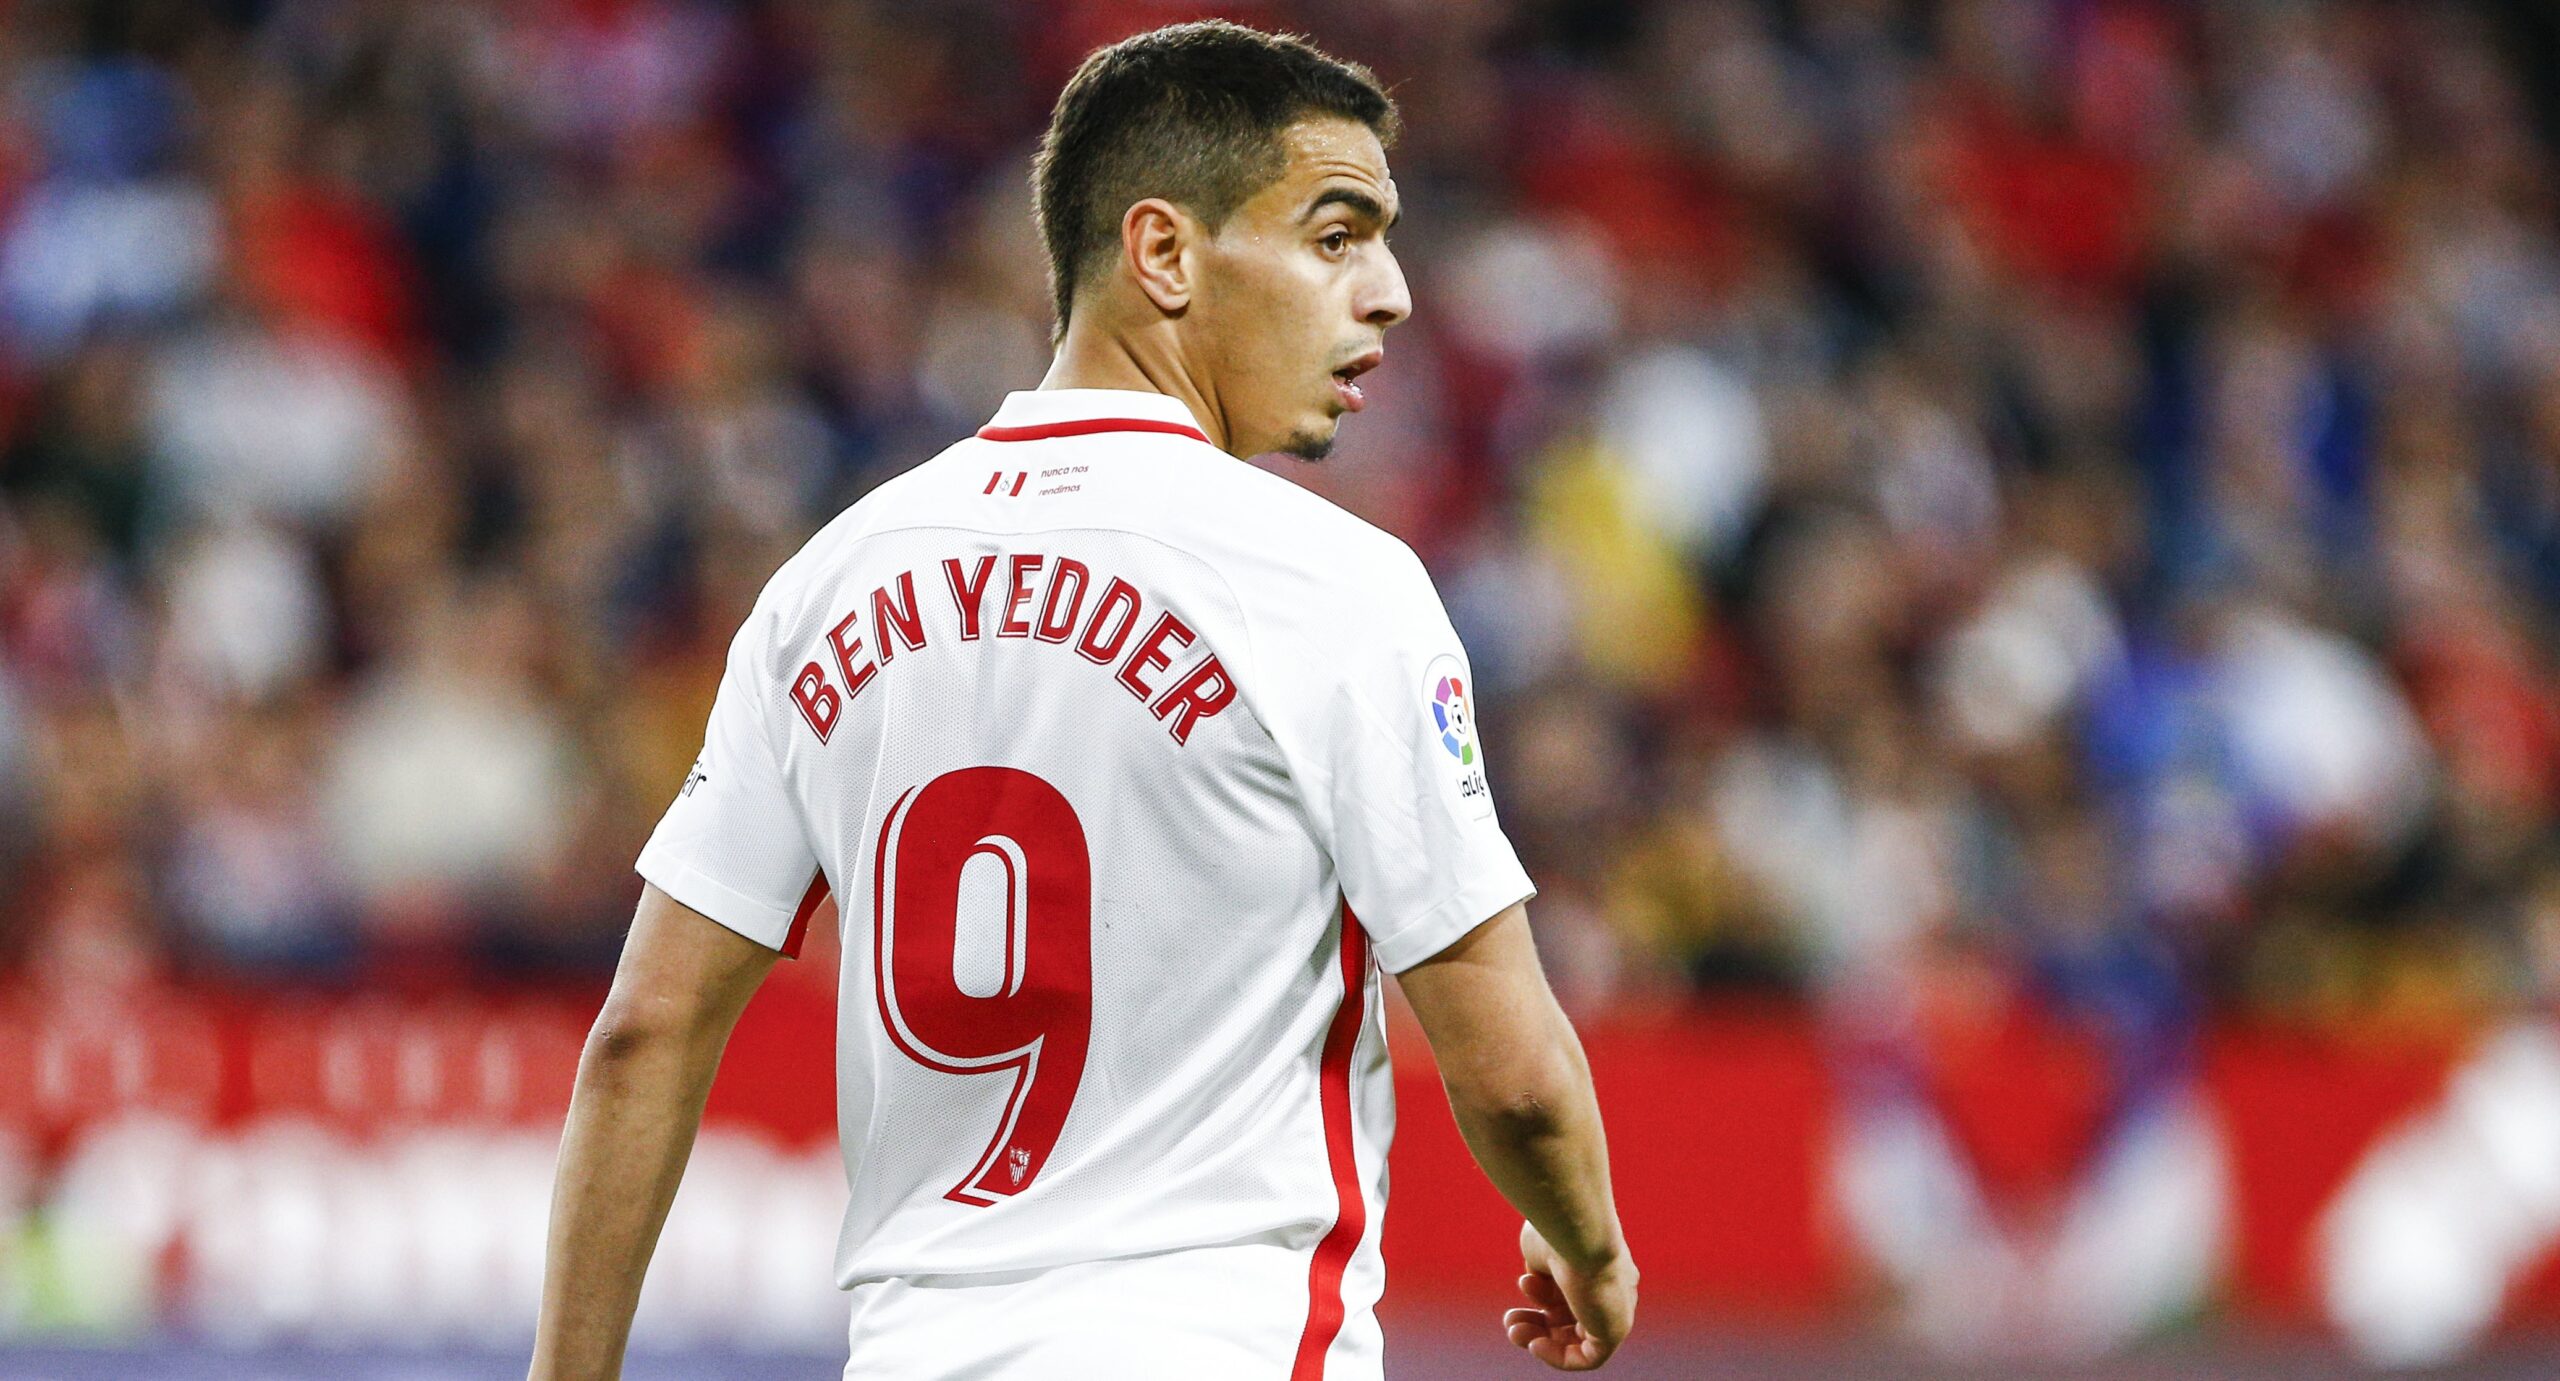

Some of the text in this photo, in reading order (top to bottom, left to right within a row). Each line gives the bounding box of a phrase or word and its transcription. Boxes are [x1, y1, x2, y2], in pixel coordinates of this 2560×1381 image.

[1040, 465, 1089, 478] nunca nos
[1039, 484, 1081, 496] rendimos
[789, 553, 1238, 746] BEN YEDDER
[1456, 769, 1487, 798] LaLig
[874, 766, 1092, 1208] 9
